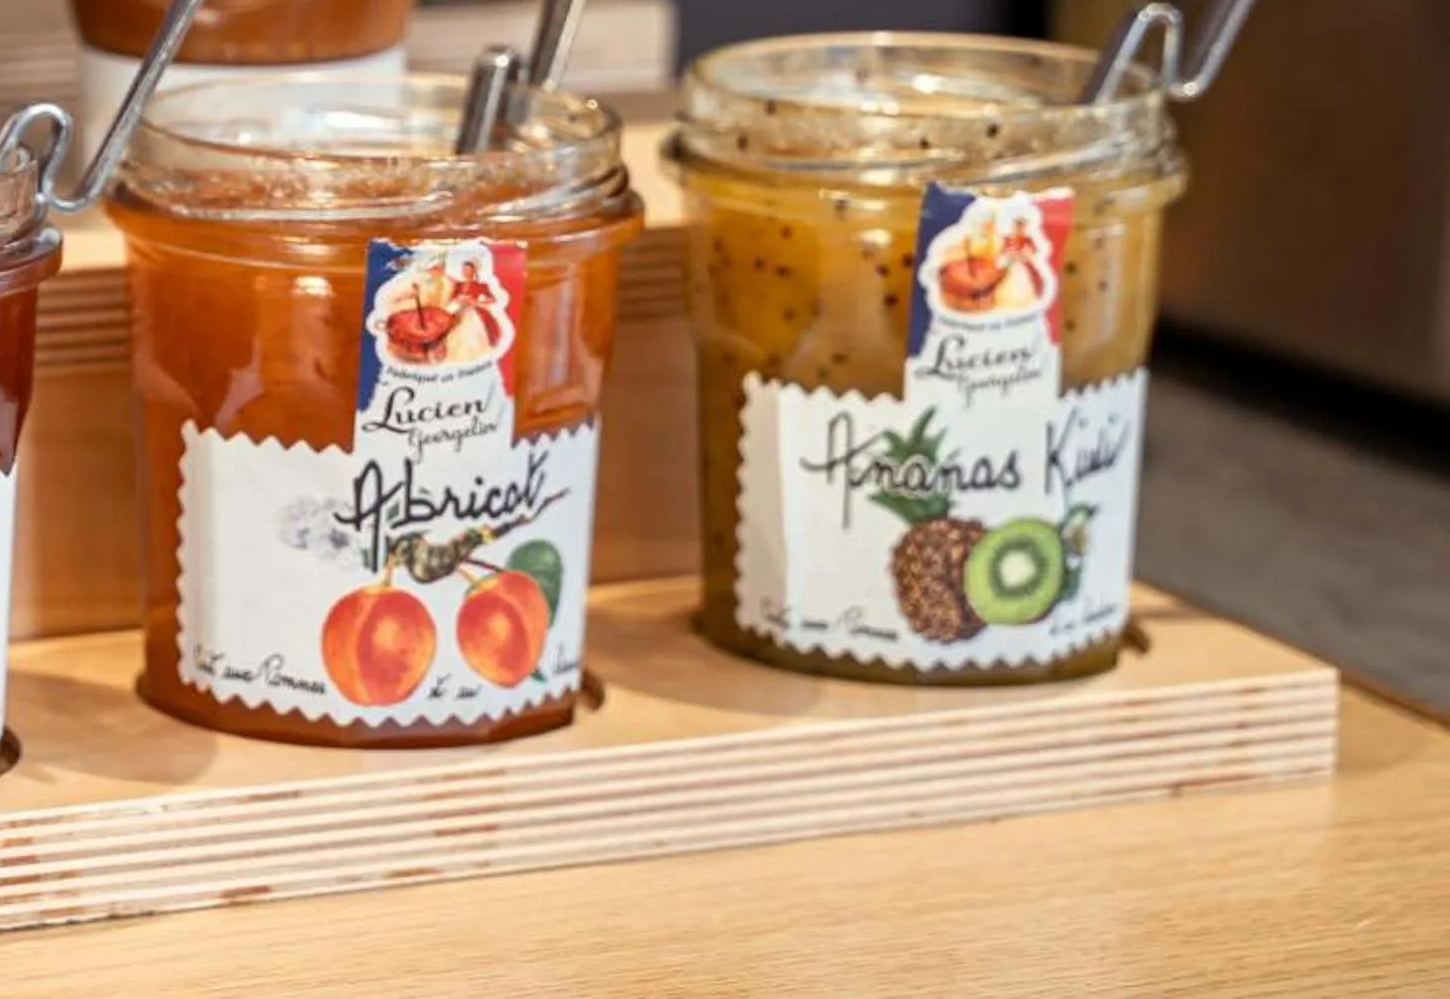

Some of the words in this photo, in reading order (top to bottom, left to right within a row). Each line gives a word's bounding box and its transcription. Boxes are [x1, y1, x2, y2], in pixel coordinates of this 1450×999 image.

[361, 378, 497, 434] Lucien
[334, 450, 550, 574] Abricot
[800, 411, 1021, 530] Ananas
